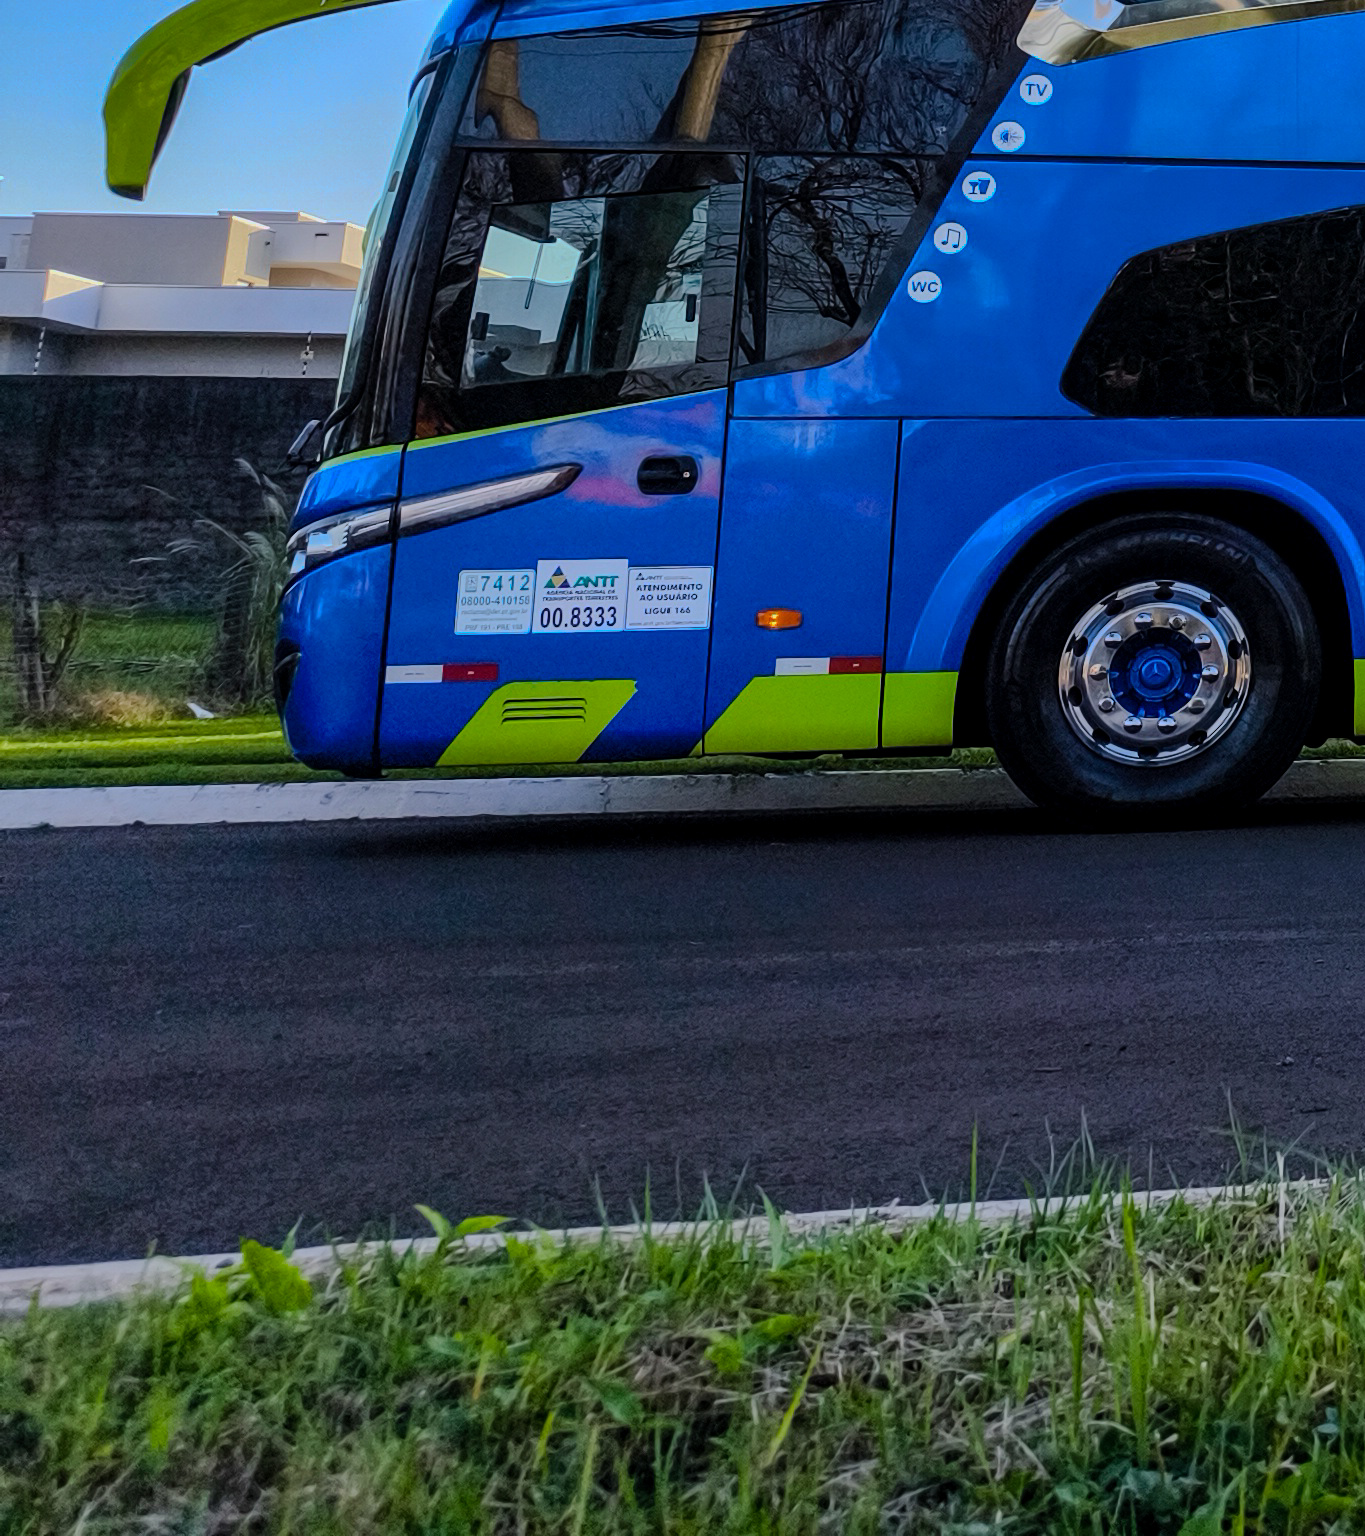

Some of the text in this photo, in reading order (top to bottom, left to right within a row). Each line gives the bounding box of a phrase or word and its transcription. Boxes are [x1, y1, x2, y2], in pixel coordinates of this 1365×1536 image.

[1025, 83, 1048, 97] TV
[911, 281, 939, 293] WC
[480, 574, 530, 591] 7412
[573, 575, 619, 589] ANTT
[636, 583, 703, 591] ATENDIMENTO
[540, 606, 616, 628] 00.8333
